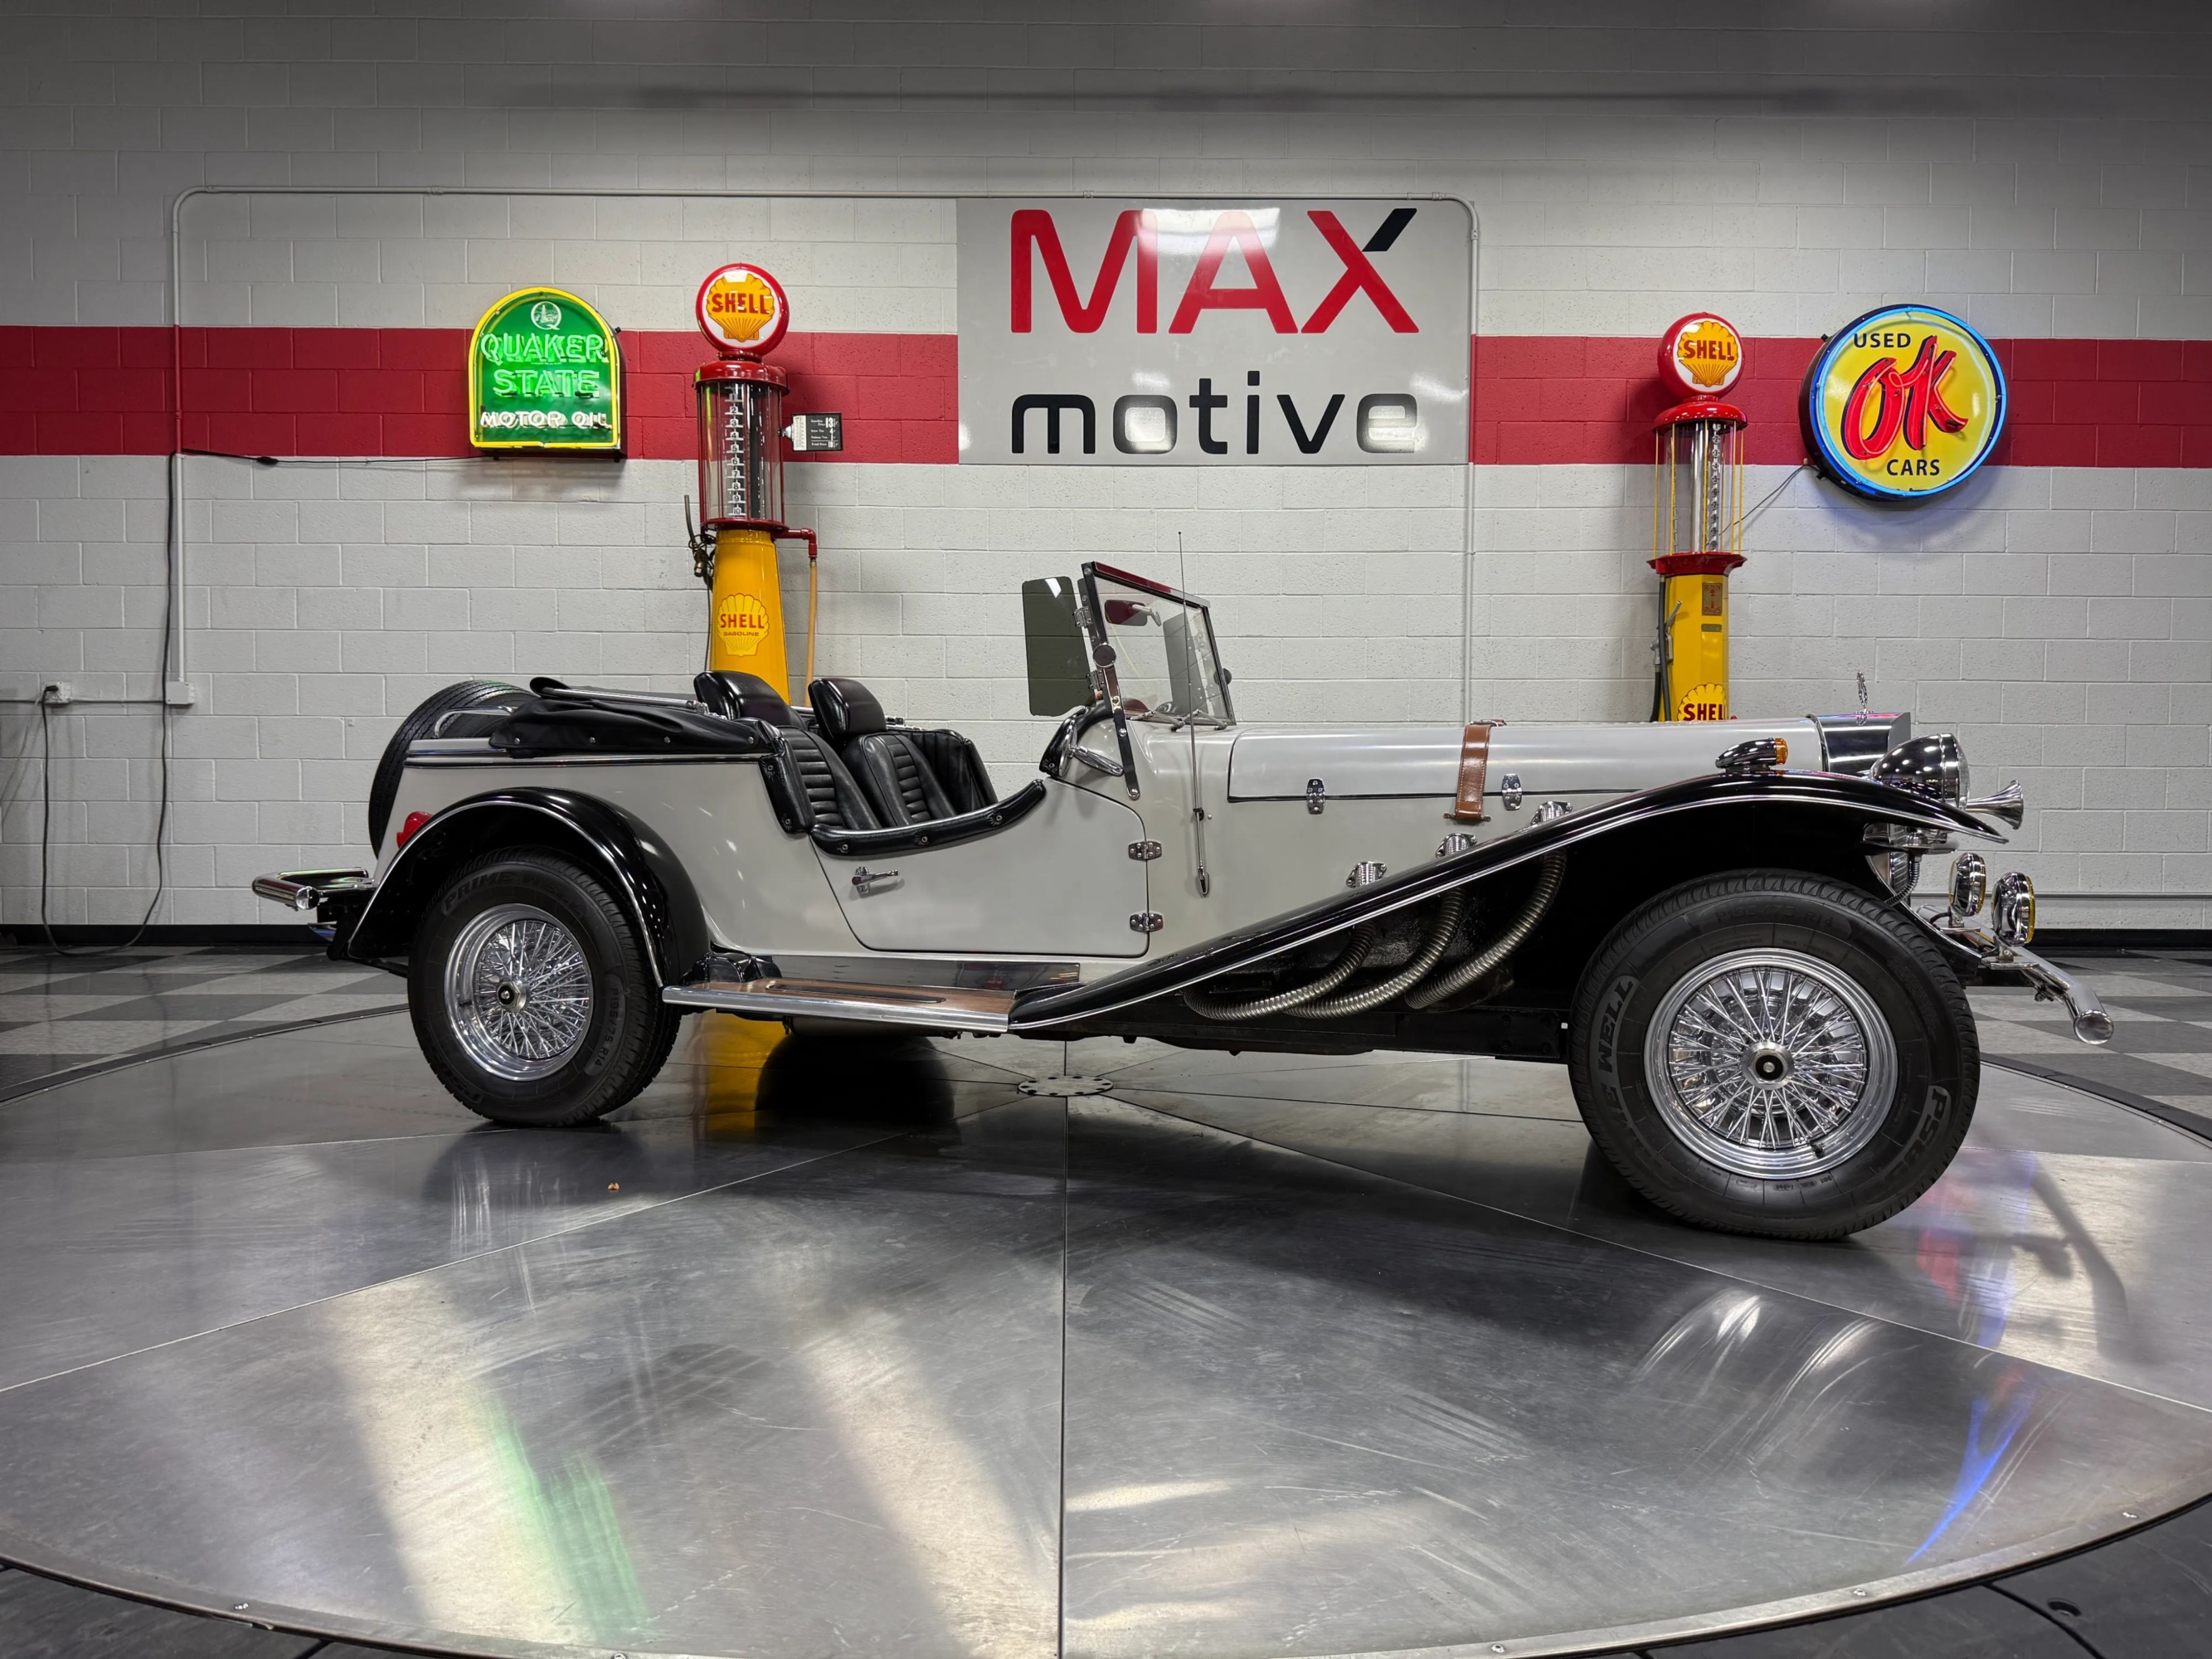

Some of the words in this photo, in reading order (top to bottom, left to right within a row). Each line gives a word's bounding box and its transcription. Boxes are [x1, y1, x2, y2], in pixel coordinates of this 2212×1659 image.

[1011, 208, 1419, 334] MAX
[712, 291, 774, 314] SHELL
[480, 332, 610, 366] QUAKER
[1683, 340, 1735, 361] SHELL
[1854, 333, 1912, 349] USED
[493, 368, 600, 398] STATE
[1840, 335, 1969, 460] OK
[479, 410, 568, 430] MOTOR
[571, 411, 612, 430] OIL
[1011, 370, 1417, 455] motive
[1886, 459, 1941, 476] CARS
[720, 613, 765, 630] SHELL
[1683, 703, 1724, 722] SHEL
[604, 987, 620, 1044] P195/75
[594, 1046, 610, 1067] R14
